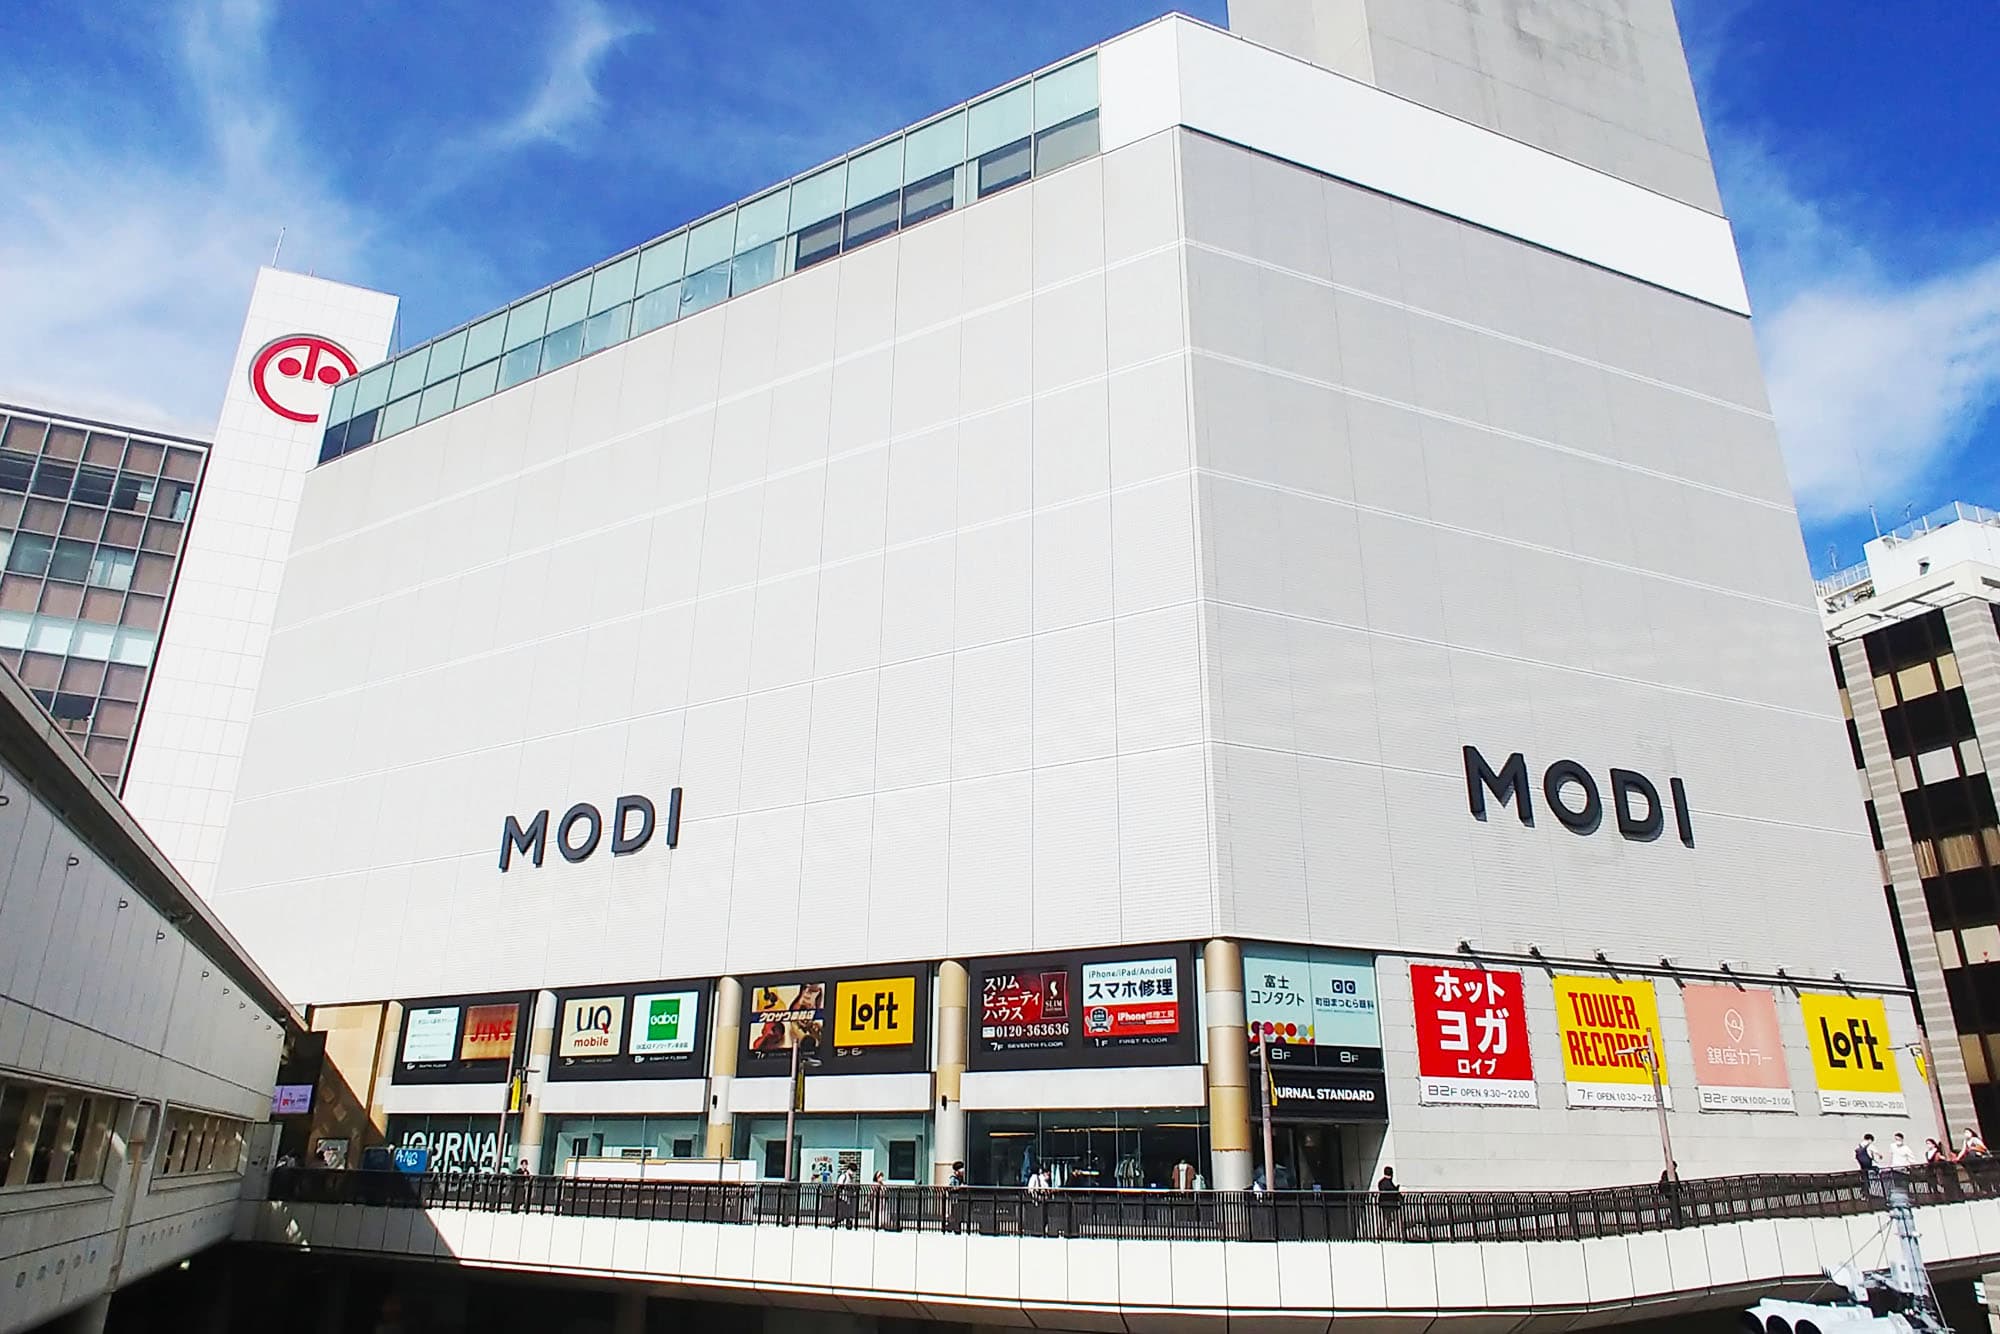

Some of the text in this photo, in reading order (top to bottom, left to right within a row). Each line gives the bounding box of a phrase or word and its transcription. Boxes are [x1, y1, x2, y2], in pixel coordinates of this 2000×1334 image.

[1463, 744, 1696, 850] MODI
[498, 787, 683, 873] MODI
[983, 975, 1020, 992] スリム
[1088, 978, 1174, 1000] スマホ修理
[1263, 974, 1290, 990] 富士
[1434, 969, 1505, 1005] ホット
[983, 991, 1040, 1007] ビューティ
[1250, 990, 1305, 1007] コンタクト
[983, 1006, 1024, 1022] ハウス
[1567, 991, 1640, 1030] TOWER
[577, 1005, 612, 1035] UQ
[469, 1019, 513, 1043] JINS
[1437, 1007, 1511, 1055] ヨガ
[573, 1036, 609, 1048] mobile
[990, 1042, 1004, 1051] 7F
[1040, 1040, 1064, 1048] FLOOR
[1094, 1038, 1109, 1048] 1F
[1271, 1048, 1292, 1060] 8F
[1339, 1051, 1359, 1063] 8F
[1706, 1045, 1774, 1066] 銀座カラー
[1457, 1058, 1497, 1075] ロイブ
[1273, 1087, 1375, 1102] URNAL STANDARD
[1460, 1088, 1482, 1097] OPEN
[1577, 1089, 1593, 1100] 7F
